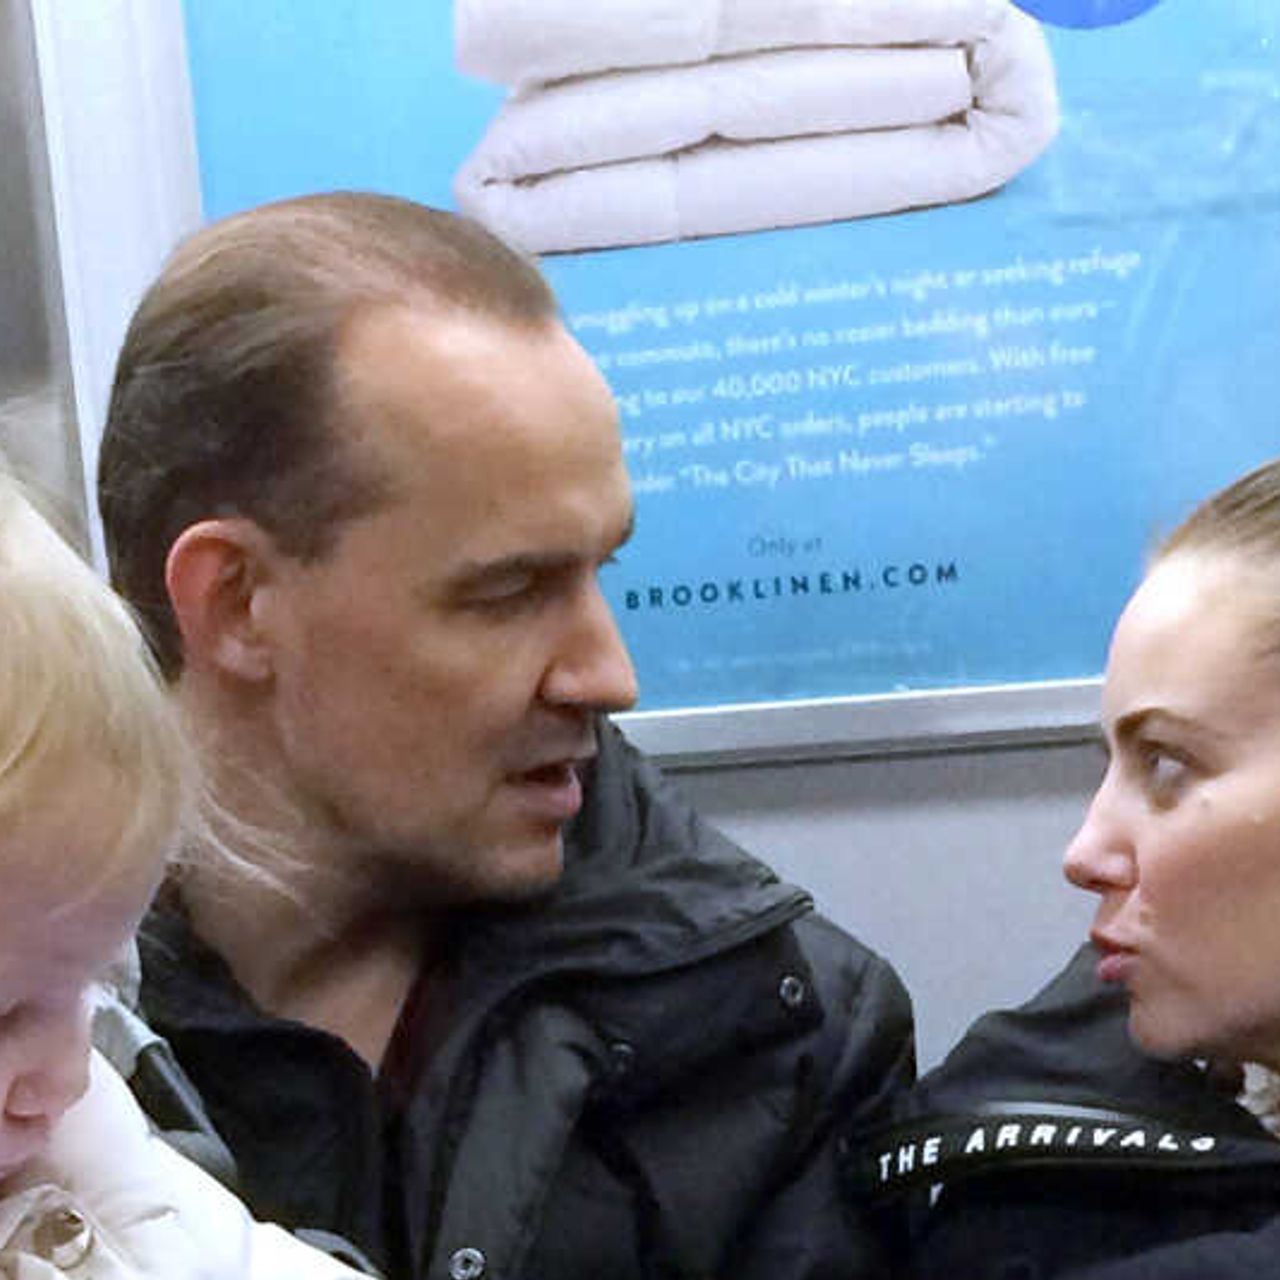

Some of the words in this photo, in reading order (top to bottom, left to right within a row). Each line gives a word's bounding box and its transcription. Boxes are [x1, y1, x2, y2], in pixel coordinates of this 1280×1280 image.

[673, 302, 699, 325] up
[754, 279, 799, 310] cold
[889, 266, 949, 303] night
[953, 270, 977, 287] or
[981, 253, 1064, 287] seeking
[1068, 246, 1141, 279] refuge
[726, 328, 797, 357] there's
[802, 329, 828, 348] no
[902, 305, 988, 342] bedding
[993, 303, 1044, 327] than
[643, 385, 668, 407] to
[712, 367, 800, 402] 40,000
[807, 363, 861, 391] NYC
[988, 342, 1045, 372] With
[1049, 338, 1097, 365] free
[691, 420, 715, 447] all
[721, 411, 774, 443] NYC
[858, 402, 928, 437] people
[934, 402, 969, 423] are
[973, 393, 1058, 421] starting
[1062, 389, 1088, 409] to
[735, 457, 781, 491] City
[784, 450, 833, 481] That
[838, 446, 905, 475] Never
[746, 535, 796, 558] Only
[802, 534, 823, 554] at
[625, 560, 959, 611] BROOKLINEN.COM
[878, 1135, 942, 1182] THE
